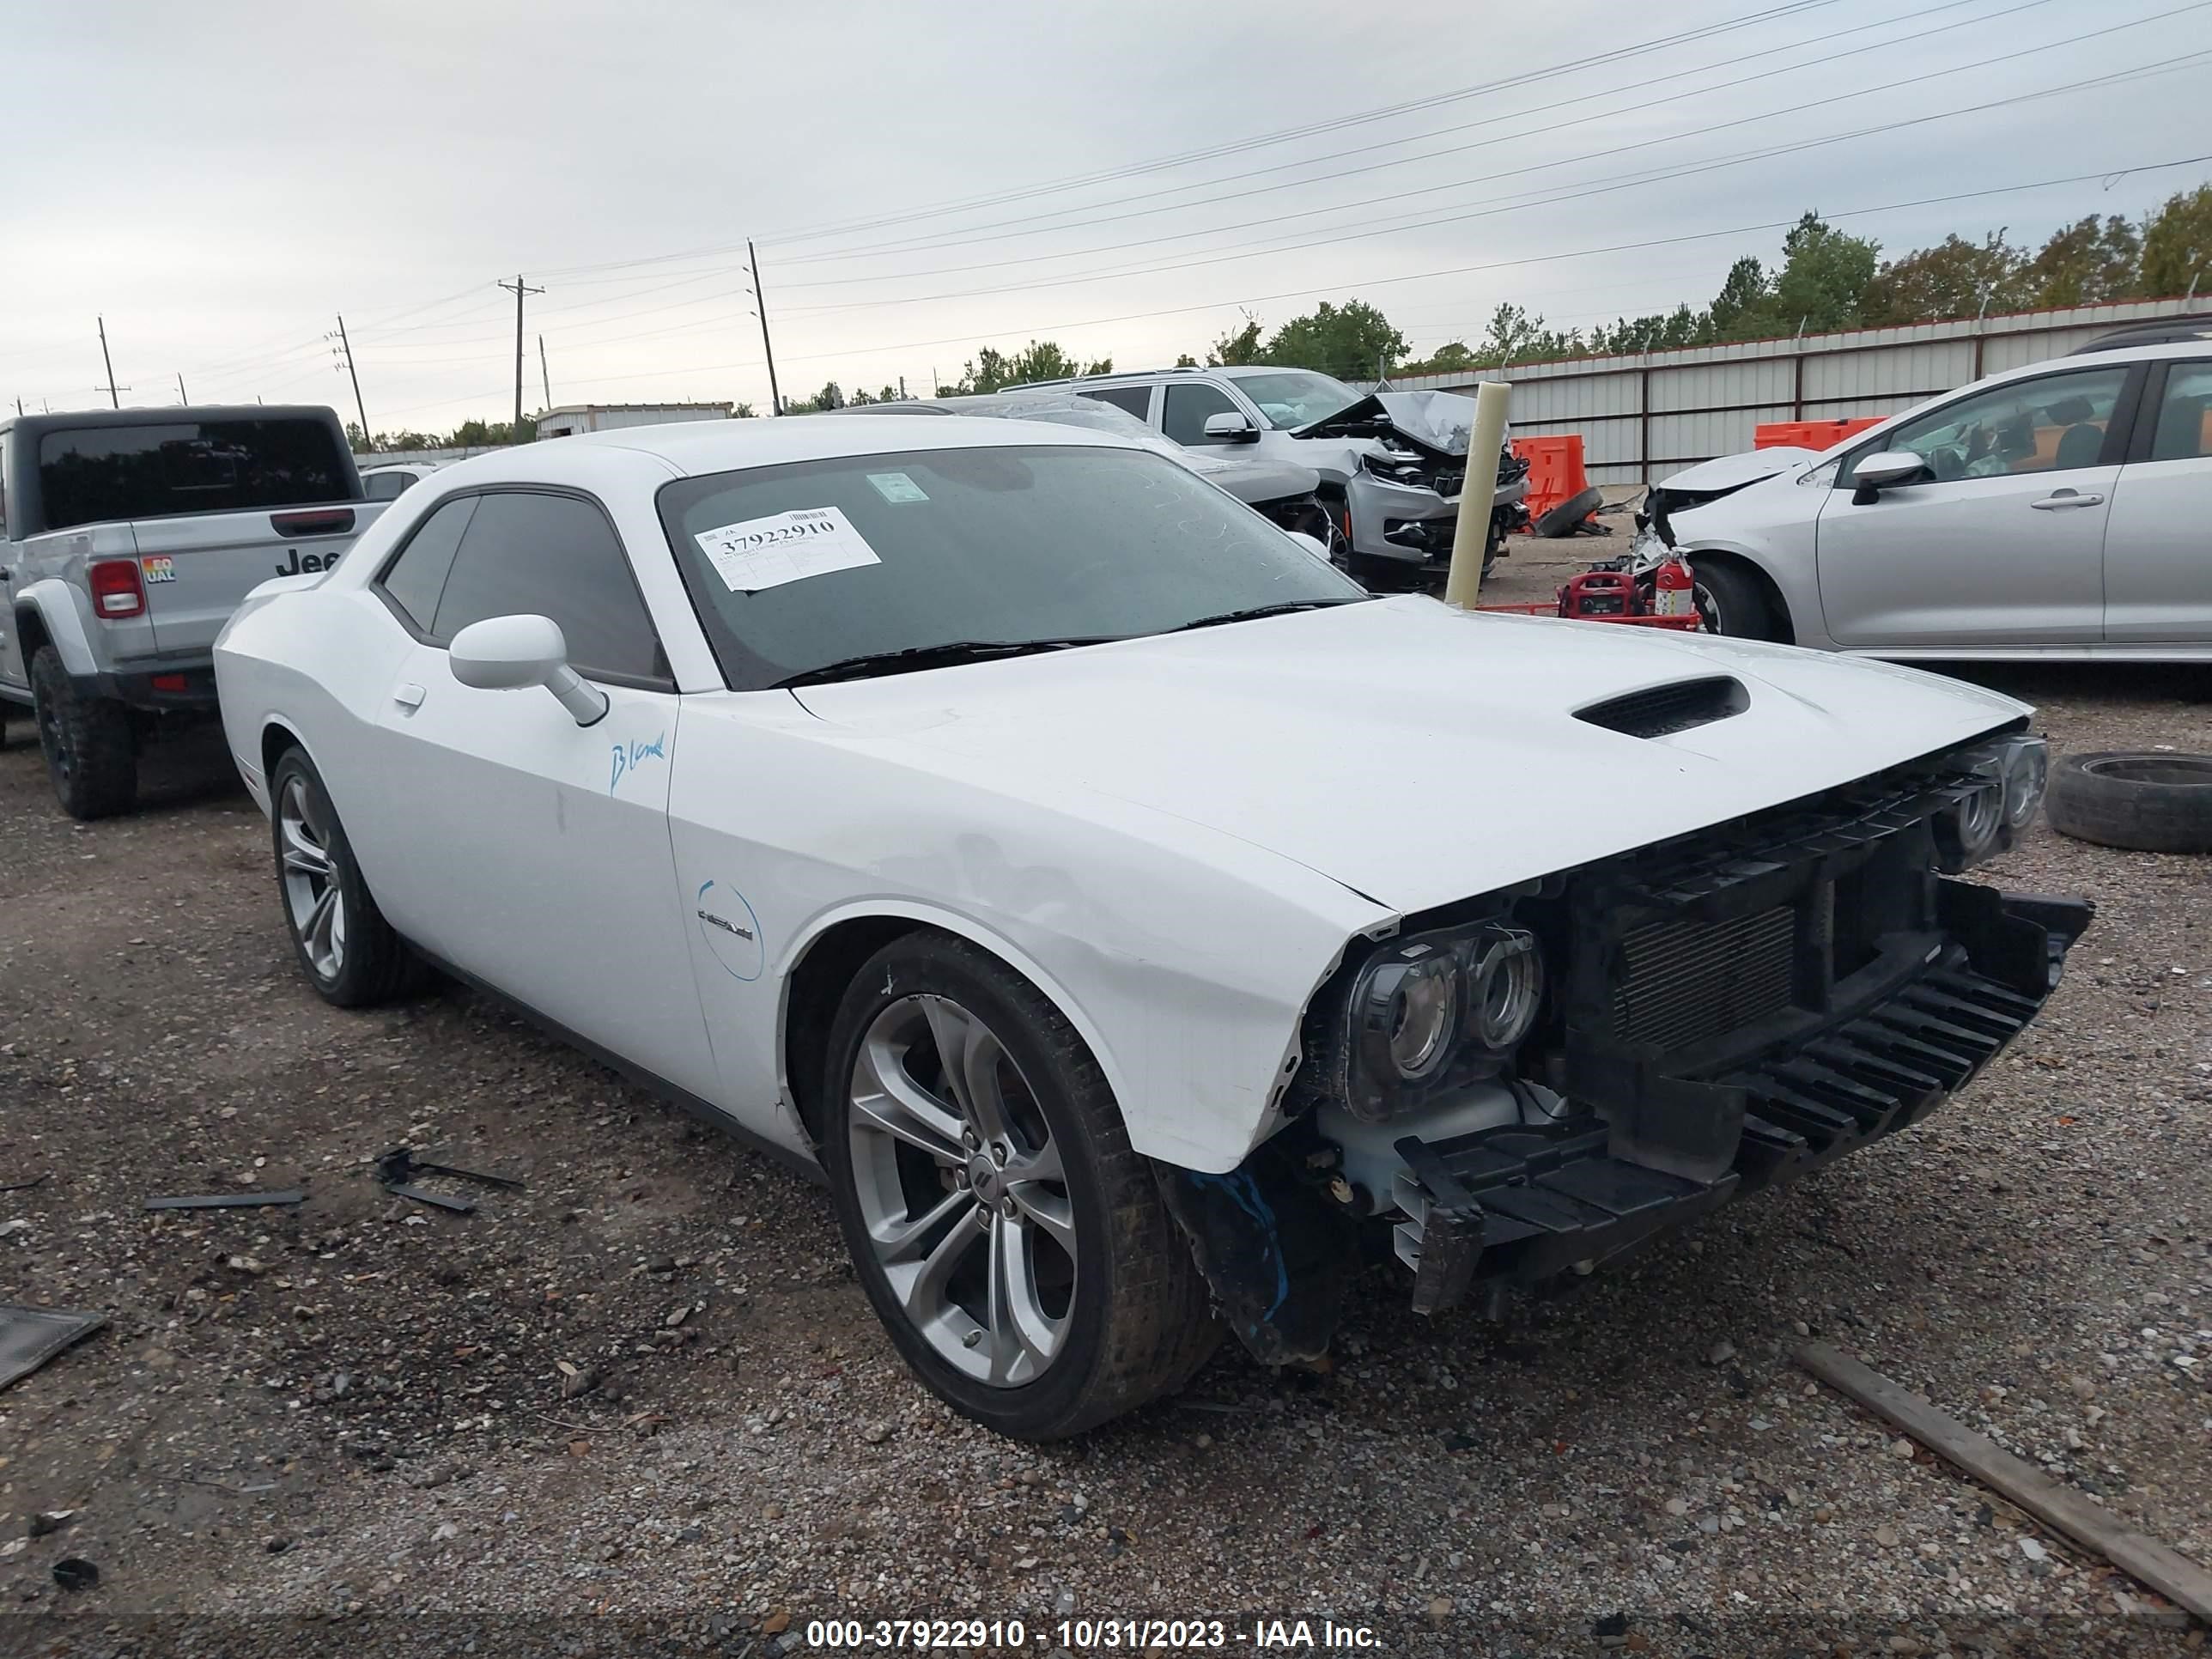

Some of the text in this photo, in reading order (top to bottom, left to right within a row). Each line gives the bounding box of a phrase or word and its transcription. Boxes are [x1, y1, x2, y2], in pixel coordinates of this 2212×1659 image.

[720, 520, 835, 556] 37922910
[147, 570, 175, 582] UAL
[276, 549, 341, 576] Jee
